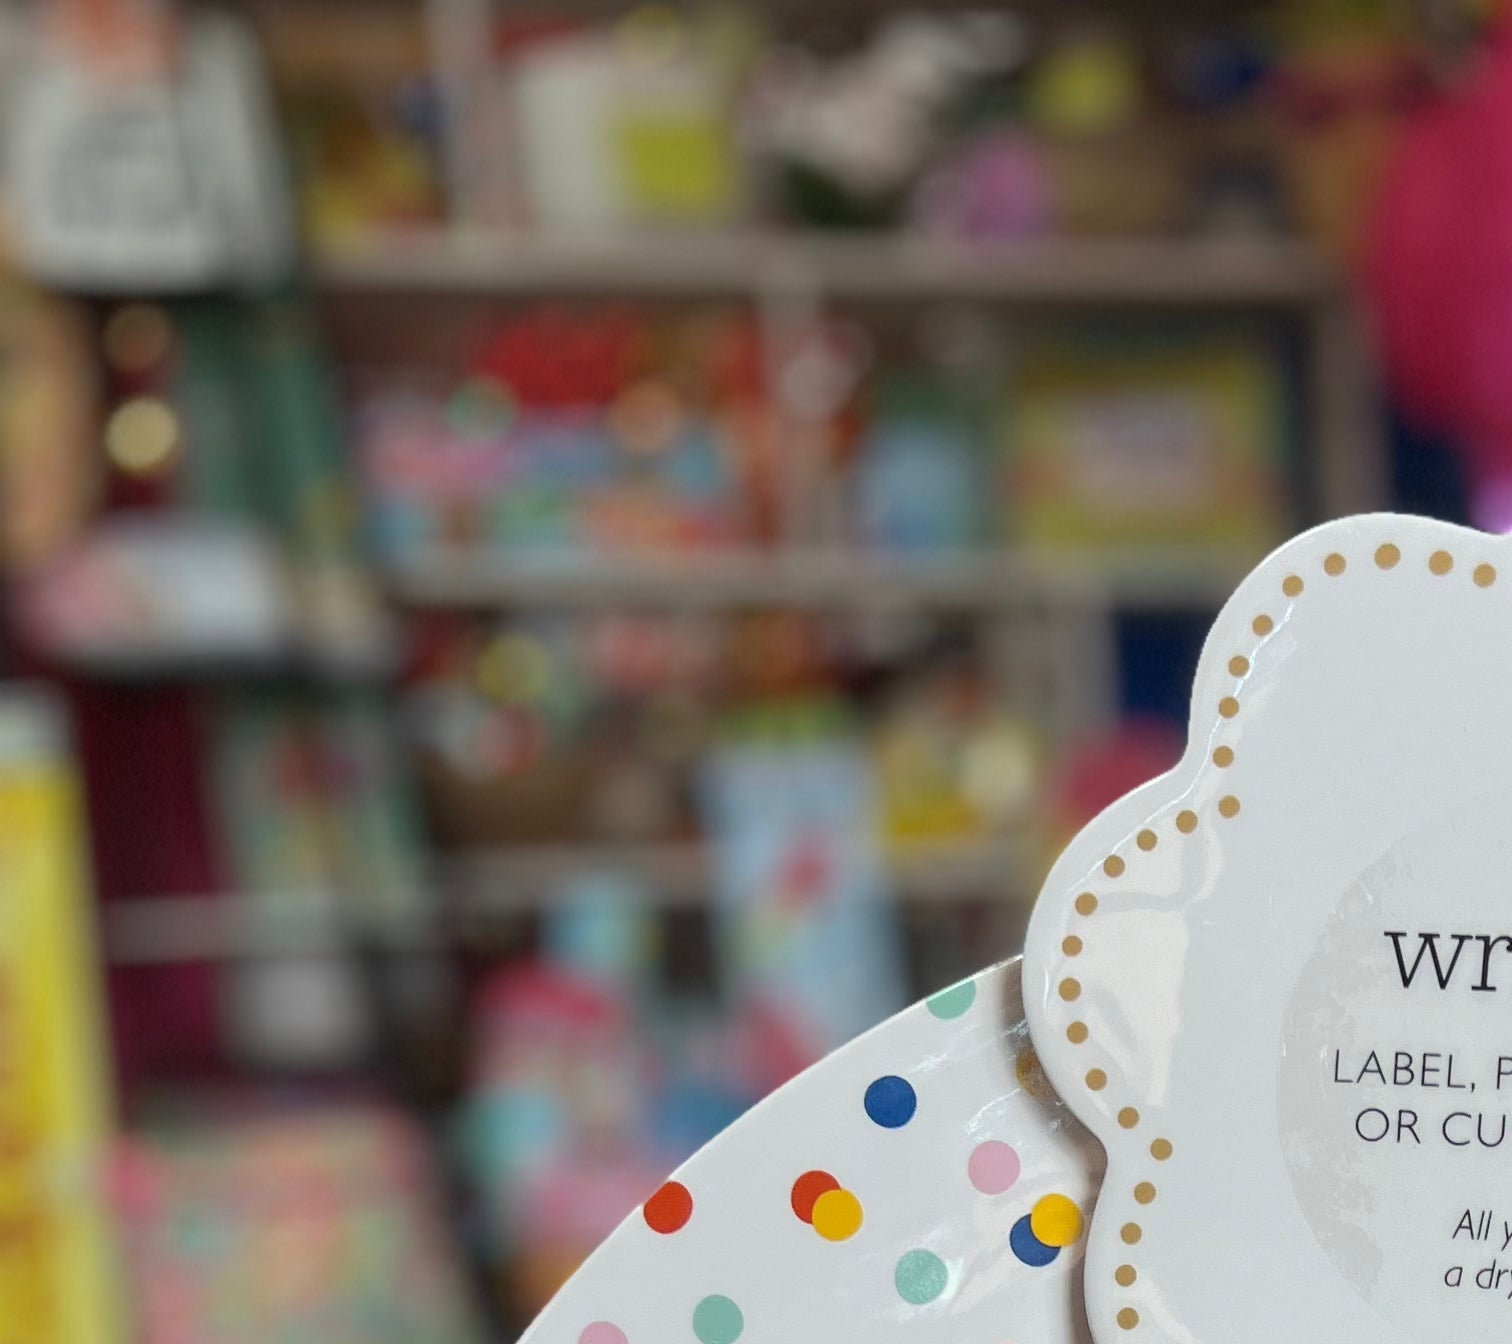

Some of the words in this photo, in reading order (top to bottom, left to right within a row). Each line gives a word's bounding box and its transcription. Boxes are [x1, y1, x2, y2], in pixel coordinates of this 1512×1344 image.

[1334, 1048, 1476, 1093] LABEL,
[1355, 1107, 1421, 1145] OR
[1451, 1208, 1493, 1241] All
[1444, 1266, 1464, 1288] a
